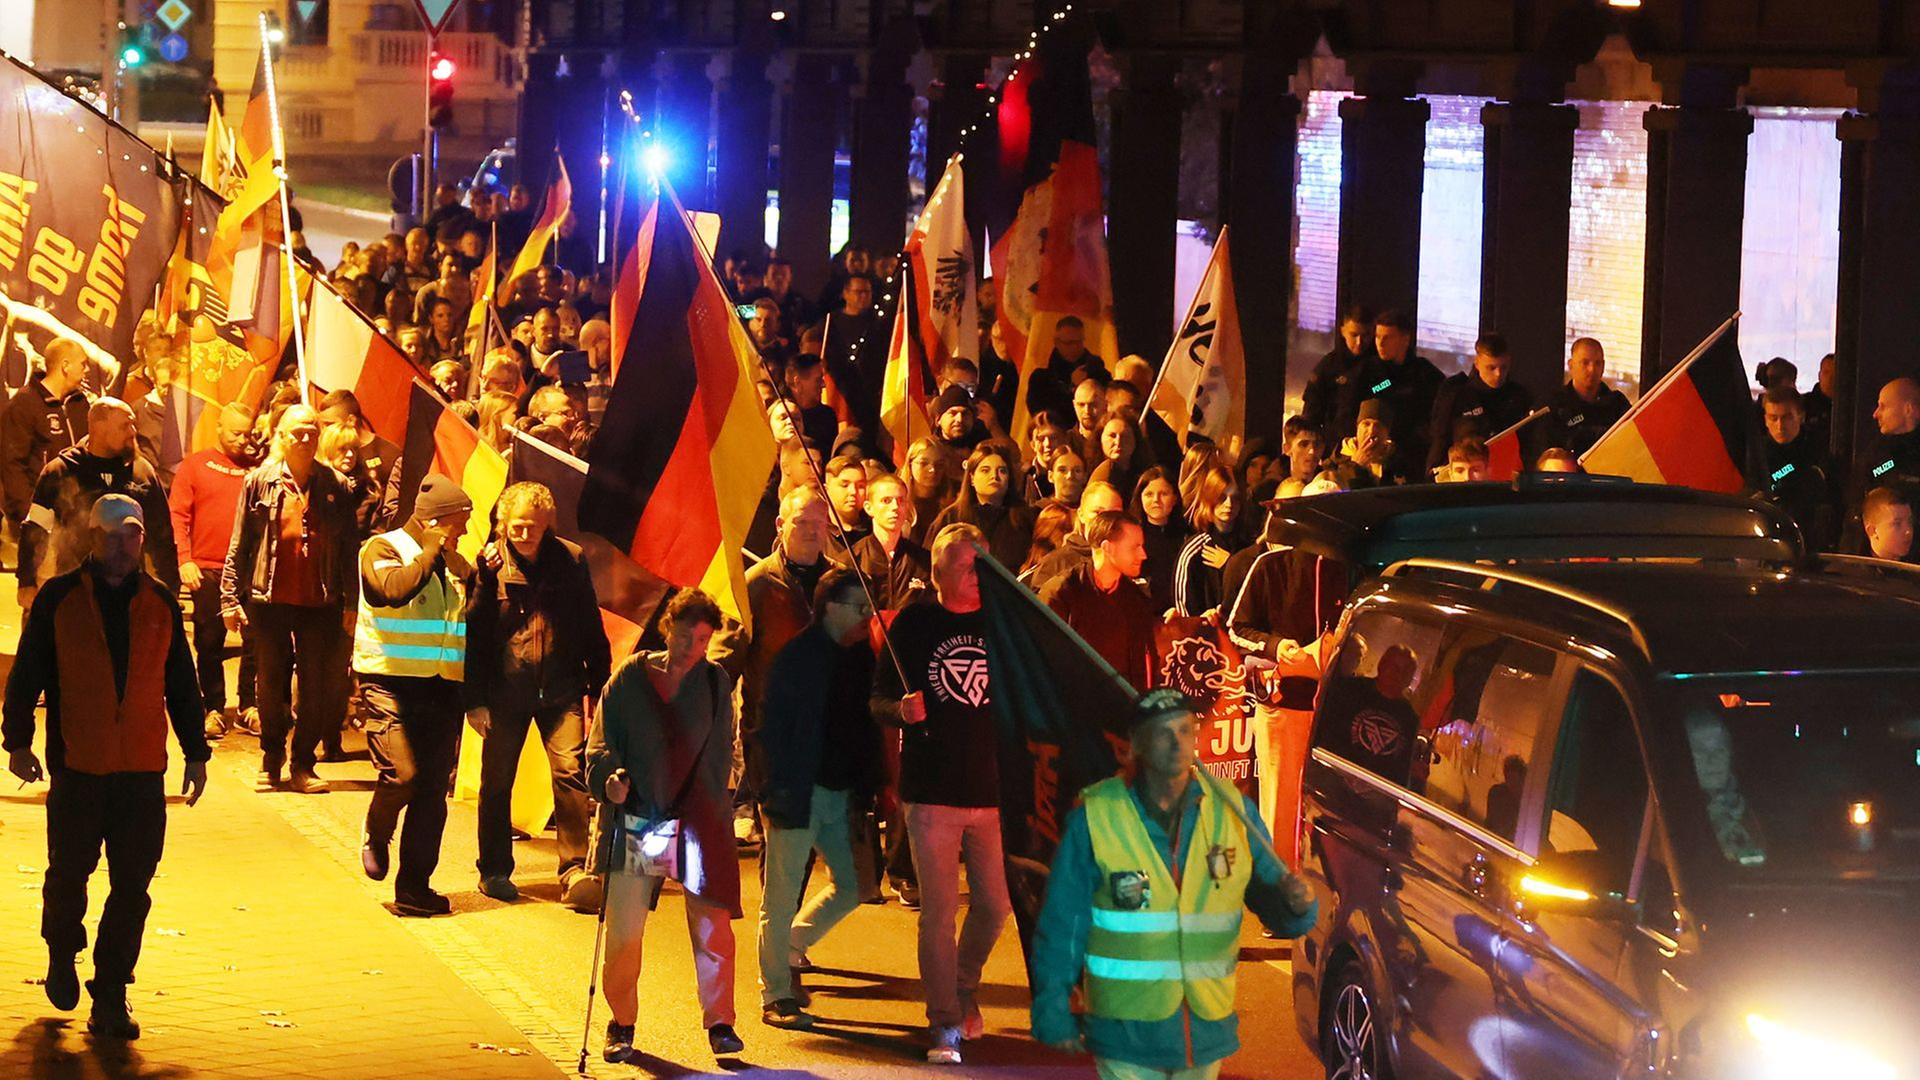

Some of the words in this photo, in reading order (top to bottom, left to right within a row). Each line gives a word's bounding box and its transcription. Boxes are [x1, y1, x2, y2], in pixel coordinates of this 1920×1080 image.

[1372, 379, 1392, 393] POLIZEI
[1771, 464, 1795, 481] POLIZEI
[1872, 460, 1895, 477] POLIZEI
[1211, 718, 1254, 755] JU
